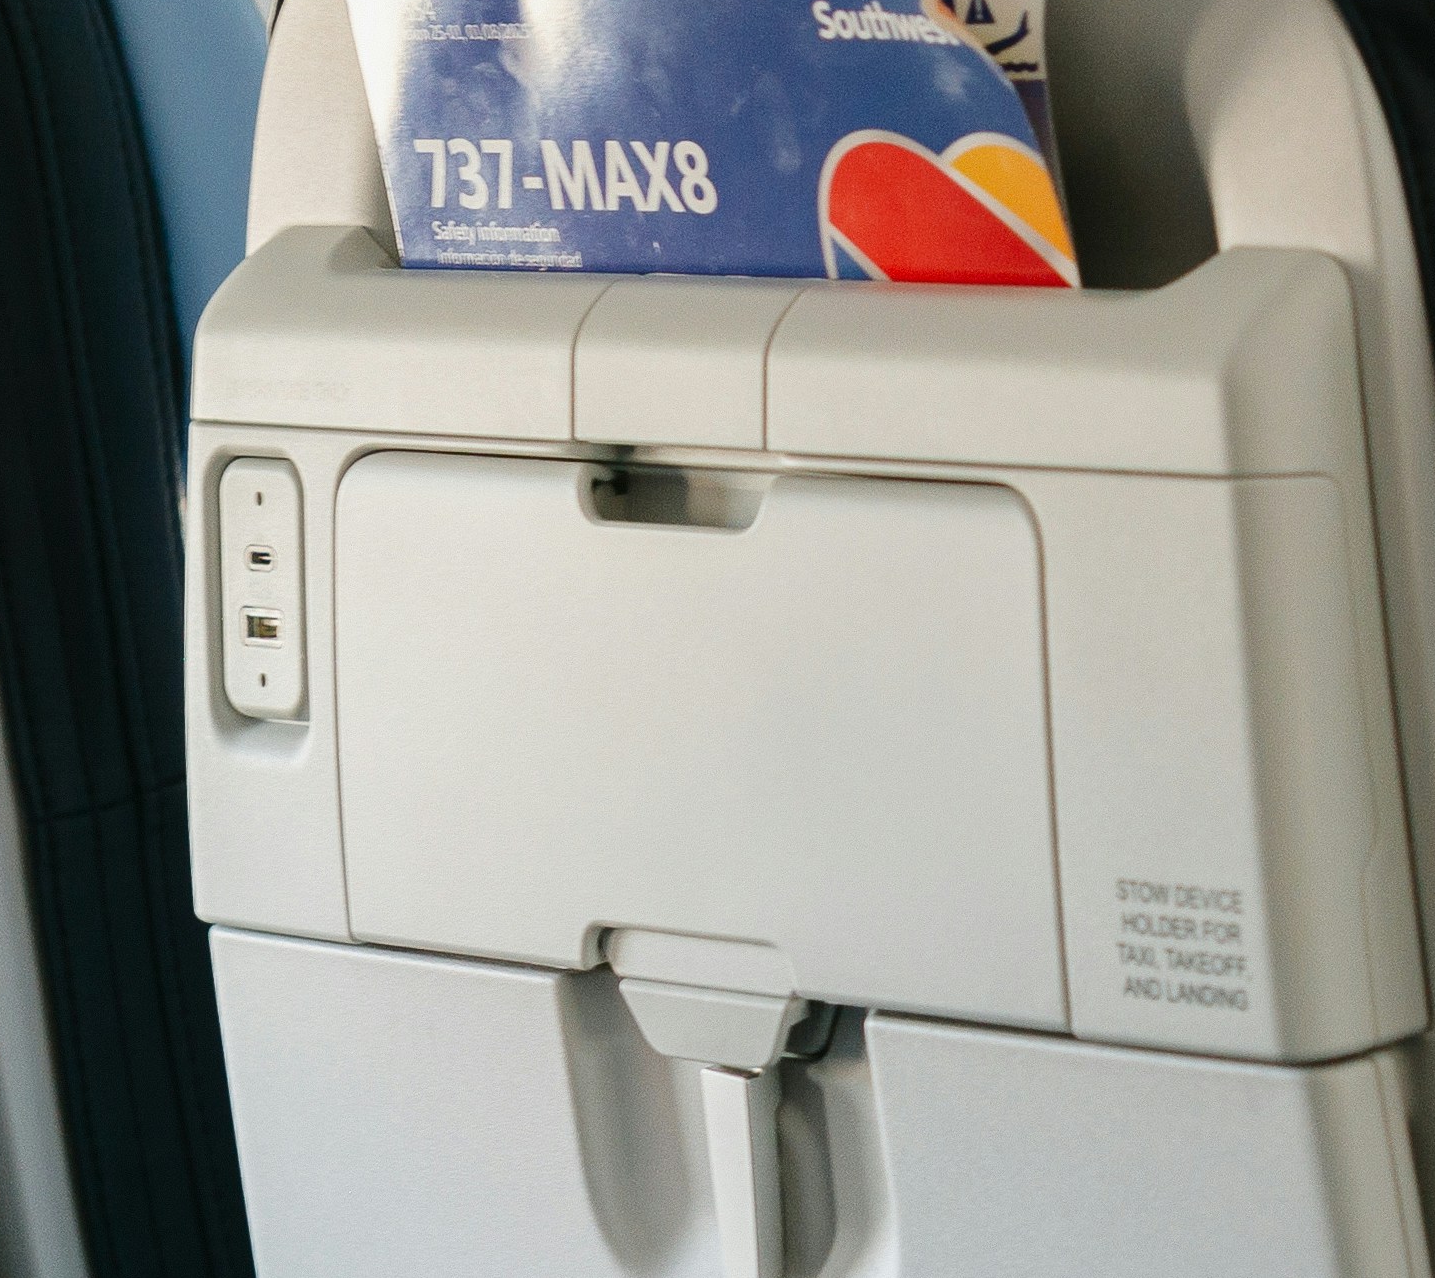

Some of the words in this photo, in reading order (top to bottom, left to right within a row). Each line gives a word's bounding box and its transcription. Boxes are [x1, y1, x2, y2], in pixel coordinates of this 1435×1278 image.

[812, 0, 960, 46] Southwes
[413, 139, 718, 215] 737-MAX8
[432, 220, 475, 245] Safety
[476, 220, 561, 242] information
[1123, 976, 1161, 1000] AND
[1165, 979, 1248, 1011] LANDING
